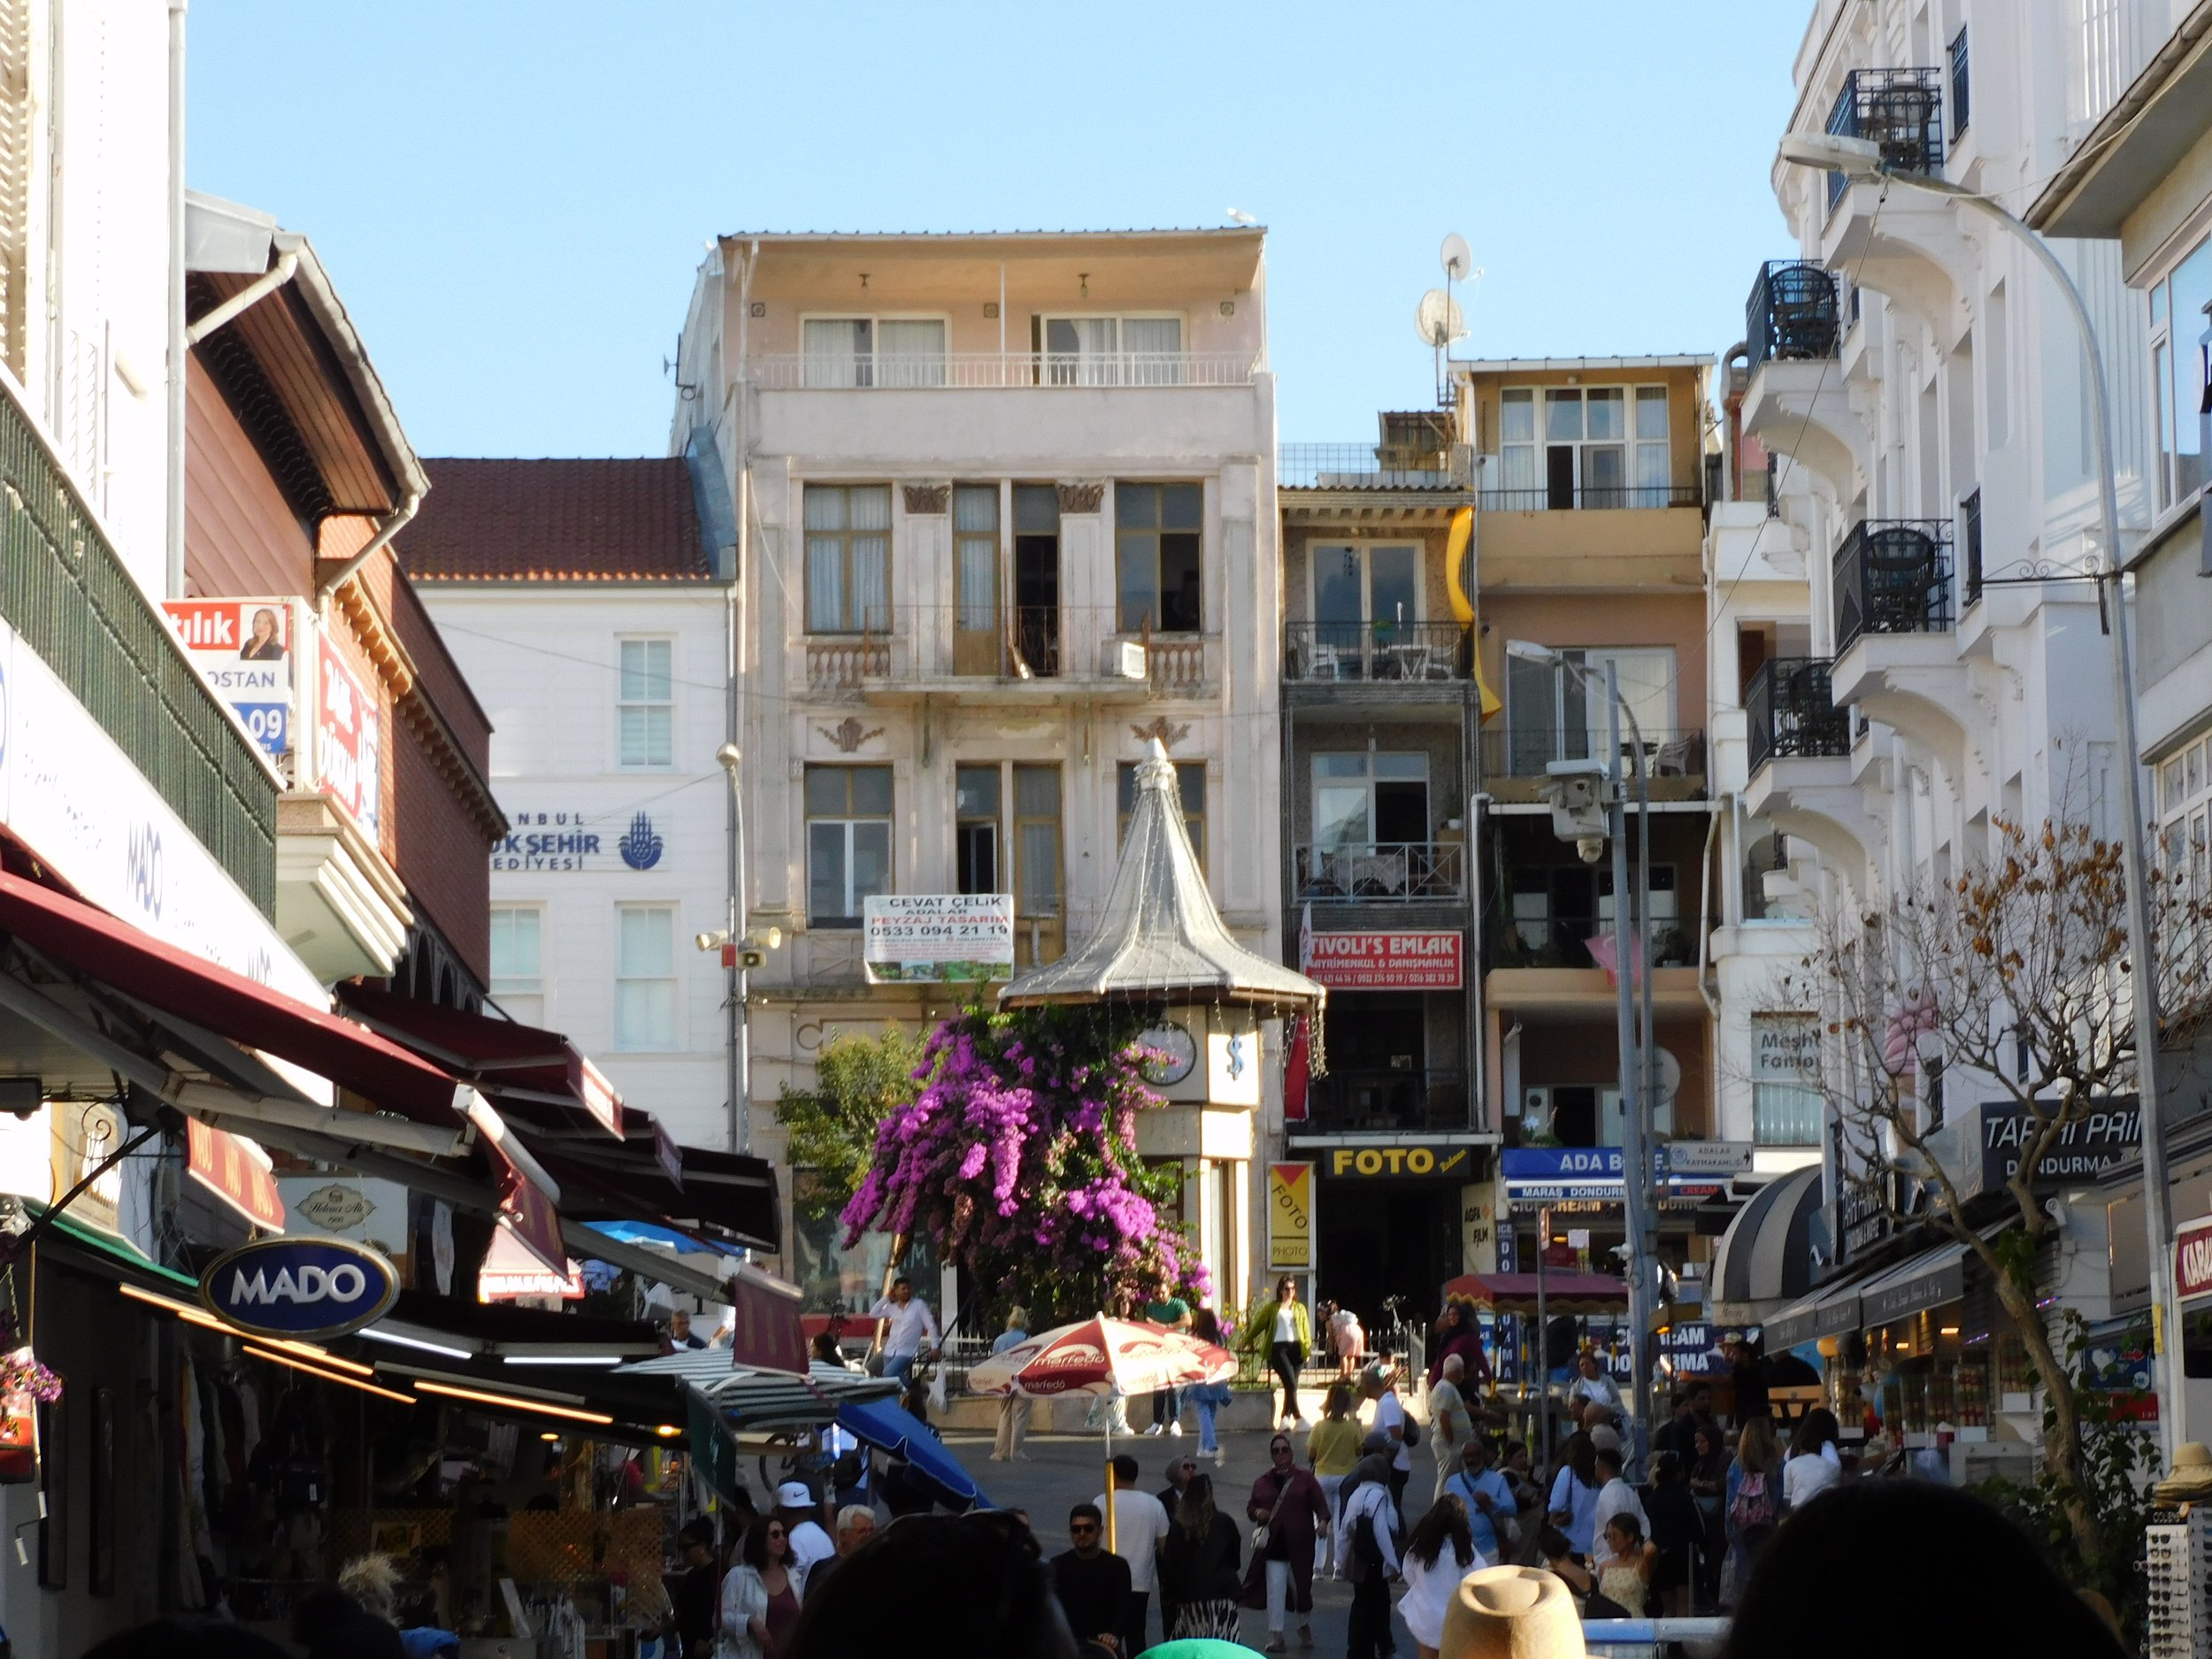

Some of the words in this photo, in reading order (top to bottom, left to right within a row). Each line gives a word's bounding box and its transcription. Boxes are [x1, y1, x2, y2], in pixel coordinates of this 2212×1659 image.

[889, 897, 946, 908] CEVAT
[937, 915, 1009, 925] TASARIM
[871, 926, 914, 936] 0533
[920, 926, 953, 936] 094
[959, 926, 979, 935] 21
[1311, 937, 1384, 956] TIVOLI'S
[1390, 936, 1454, 956] EMLAK
[1388, 958, 1455, 971] DANIŞMANLIK
[1333, 1148, 1434, 1176] FOTO
[1560, 1154, 1602, 1171] ADA
[1271, 1184, 1308, 1230] FOTO
[1272, 1245, 1308, 1257] PHOTO
[230, 1263, 366, 1306] MADO
